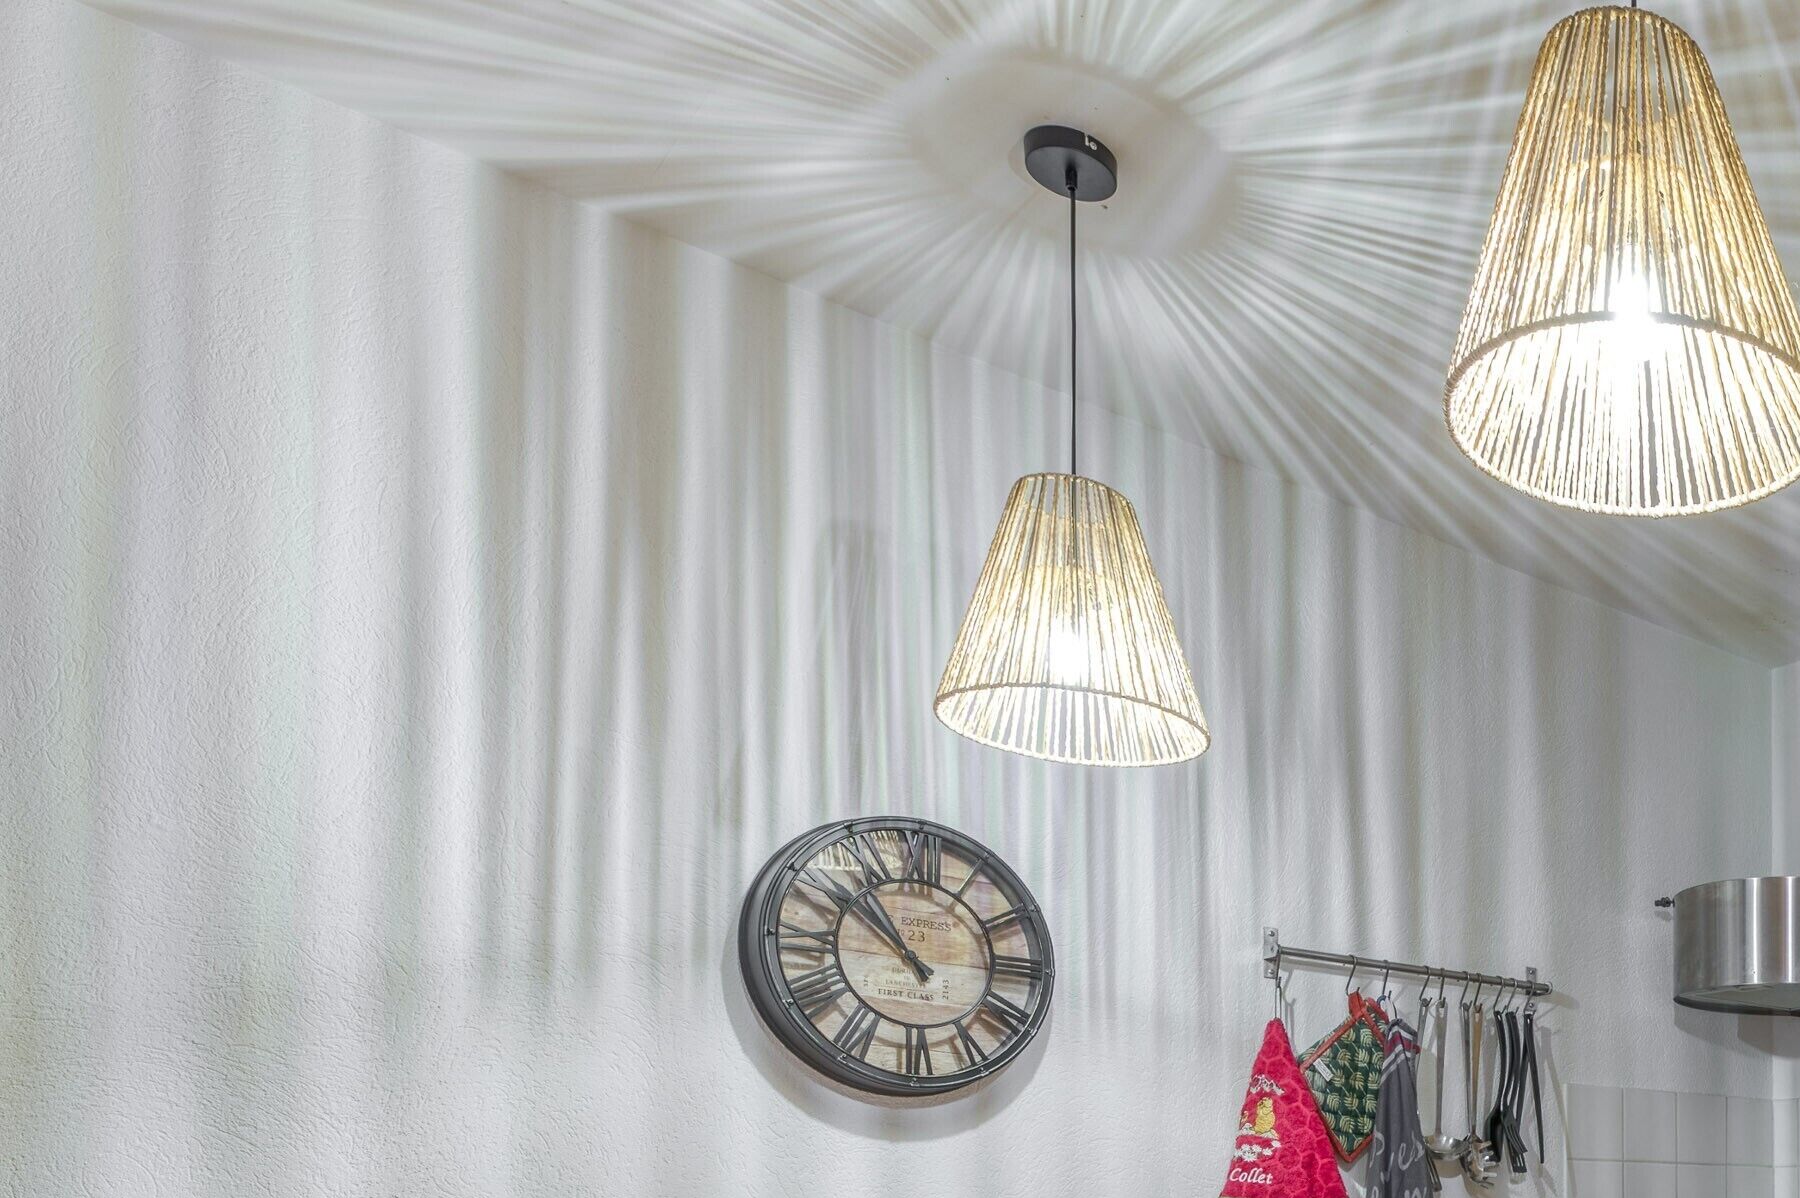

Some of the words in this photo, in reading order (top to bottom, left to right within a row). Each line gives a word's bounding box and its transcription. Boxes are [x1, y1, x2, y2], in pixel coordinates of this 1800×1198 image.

[839, 834, 893, 887] XI
[904, 830, 942, 884] XII
[901, 916, 952, 931] EXPRESS
[982, 902, 1031, 929] II
[908, 930, 926, 943] 23
[993, 955, 1041, 980] III
[878, 988, 903, 997] FIRST
[907, 991, 935, 1001] CLASS
[905, 1027, 934, 1076] VI
[1229, 1167, 1273, 1184] Collet
